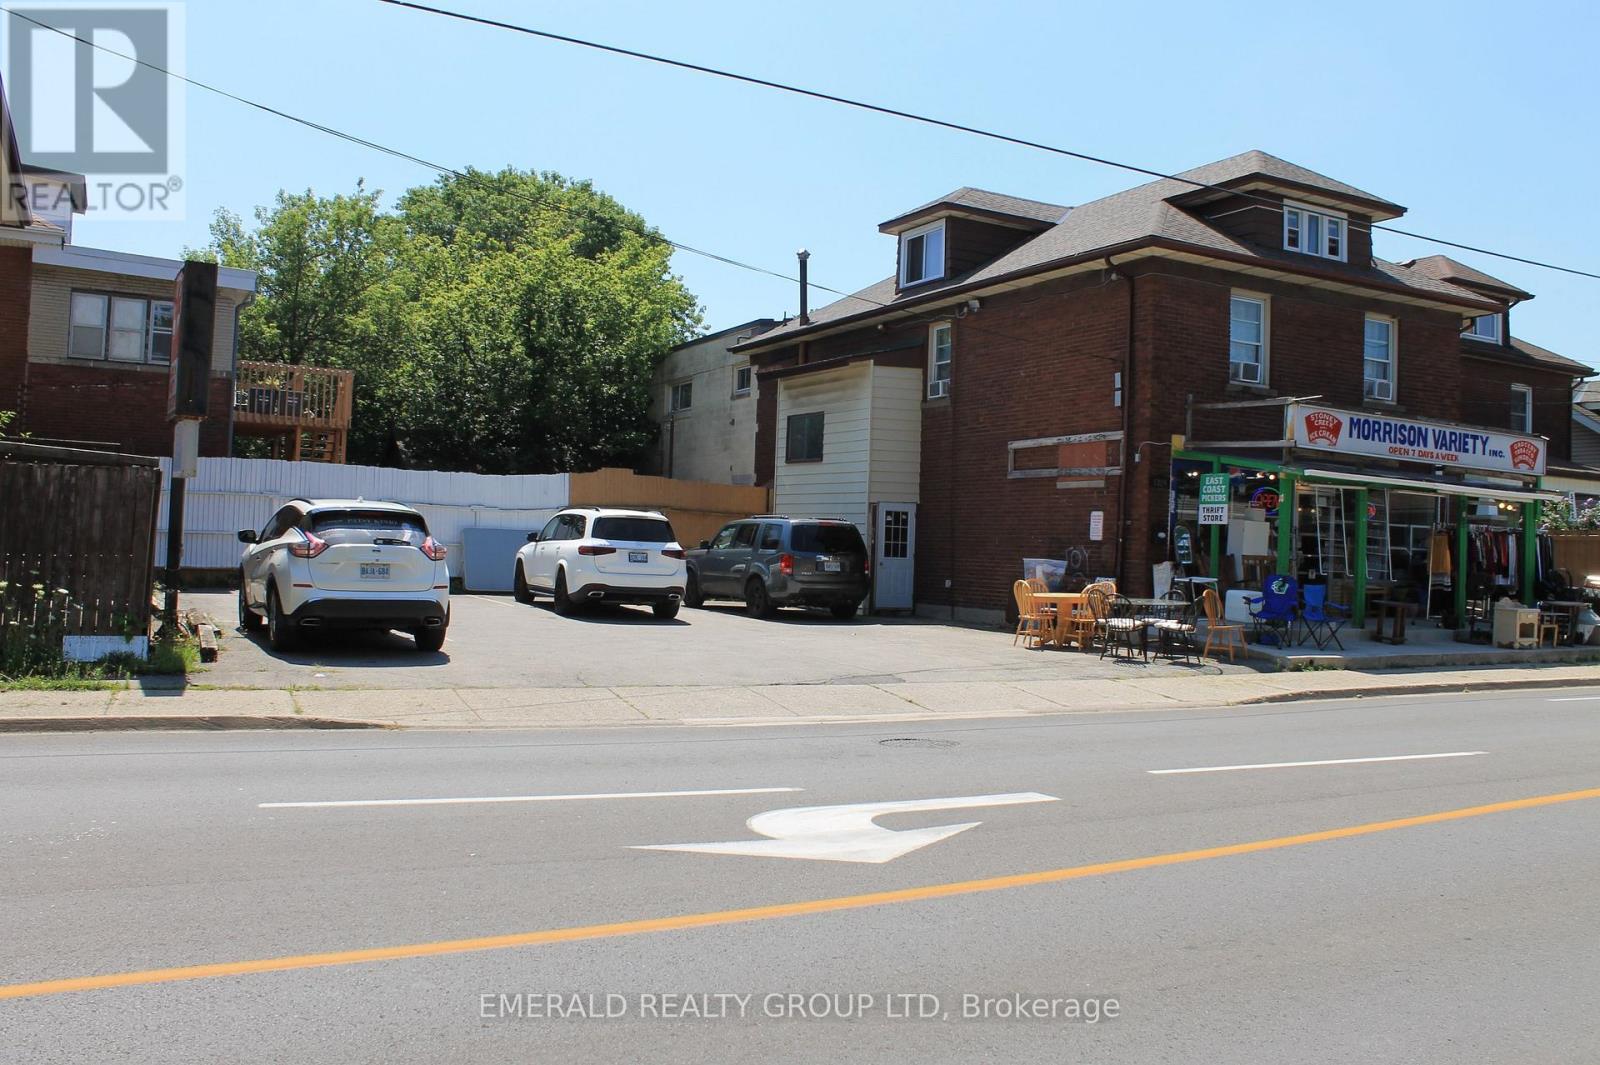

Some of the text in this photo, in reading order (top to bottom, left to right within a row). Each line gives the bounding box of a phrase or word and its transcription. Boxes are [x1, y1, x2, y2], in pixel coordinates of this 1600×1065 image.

[1310, 412, 1338, 424] STONEY
[1309, 430, 1318, 441] ICE
[1349, 417, 1428, 449] MORRISON
[1432, 428, 1490, 456] VARIETY
[1388, 446, 1410, 456] OPEN
[1418, 449, 1434, 459] DAYS
[1434, 452, 1440, 460] A
[1440, 453, 1459, 462] WEEK
[1205, 476, 1224, 485] EAST
[1202, 485, 1226, 494] COAST
[1201, 494, 1226, 502] PICKERS
[1202, 506, 1225, 514] THRIFT
[1202, 514, 1223, 522] STORE
